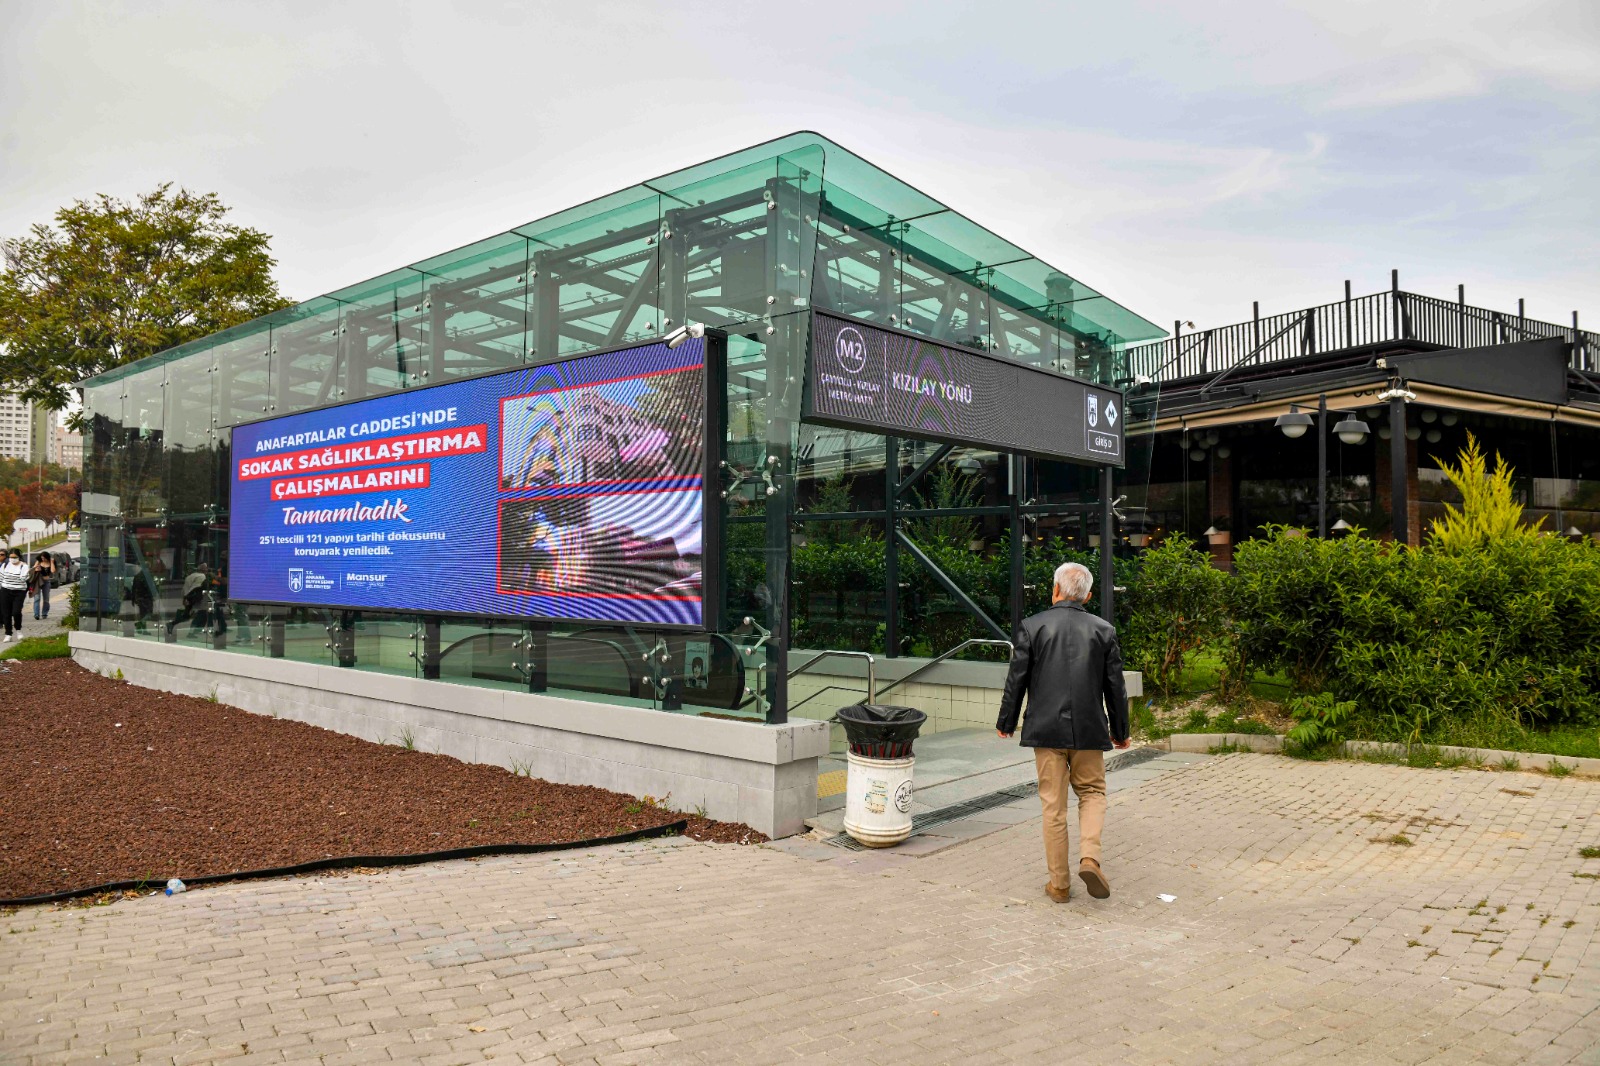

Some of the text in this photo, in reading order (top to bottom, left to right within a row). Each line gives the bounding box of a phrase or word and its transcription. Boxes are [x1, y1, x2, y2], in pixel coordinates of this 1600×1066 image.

[840, 339, 863, 361] M2
[893, 371, 972, 404] KIZILAY YÖNÜ
[256, 427, 346, 452] ANAFARTALAR
[241, 431, 482, 476] SOKAK SAĞLIKLAŞTIRMA
[274, 467, 424, 499] ÇALIŞMALARINI
[282, 498, 412, 524] Tamamladık
[276, 534, 304, 544] tescilli
[306, 534, 323, 543] 121
[324, 534, 354, 544] yapıyı
[356, 532, 385, 542] tarihi
[387, 531, 446, 541] dokusunu
[294, 545, 394, 557] koruyarak yeniledik.
[346, 572, 388, 582] Mansur
